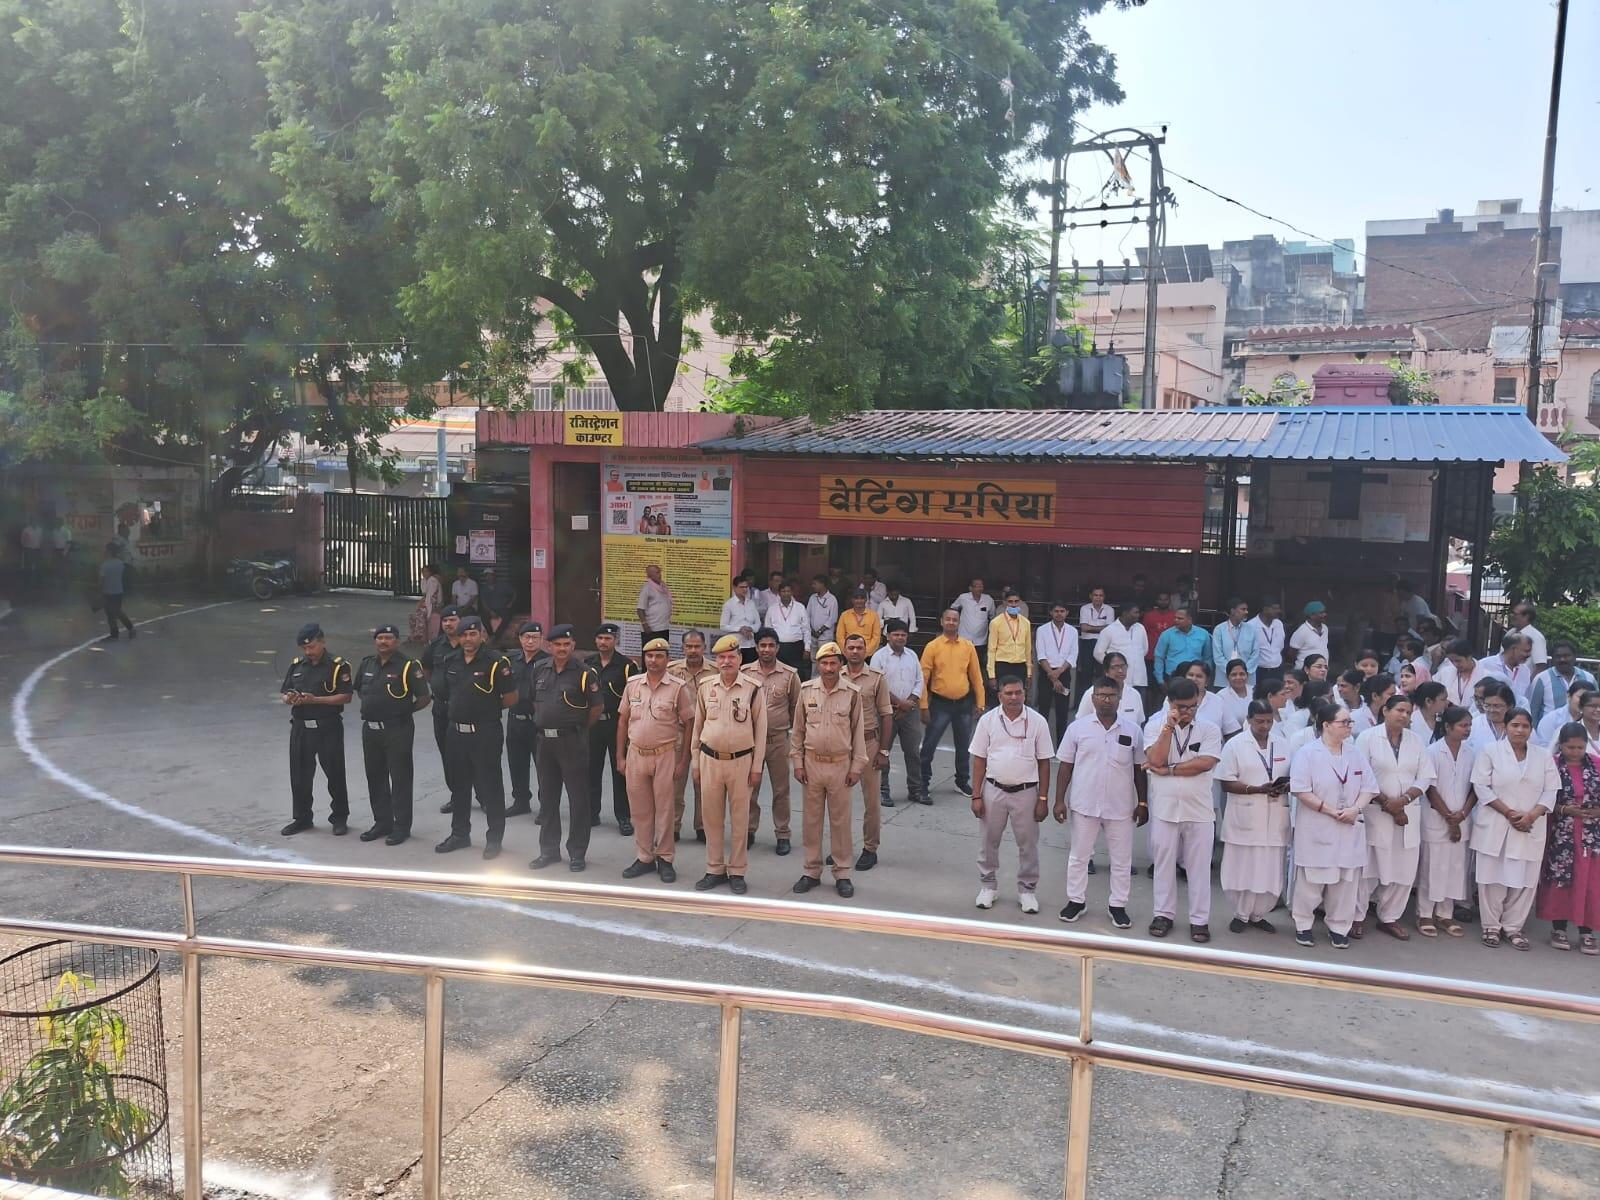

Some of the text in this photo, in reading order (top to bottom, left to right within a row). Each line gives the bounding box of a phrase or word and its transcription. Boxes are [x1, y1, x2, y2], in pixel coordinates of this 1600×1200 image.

[568, 415, 620, 431] रजिस्ट्रेशन
[575, 433, 613, 443] काउण्टर
[827, 478, 1053, 520] वेटिंग एरिया
